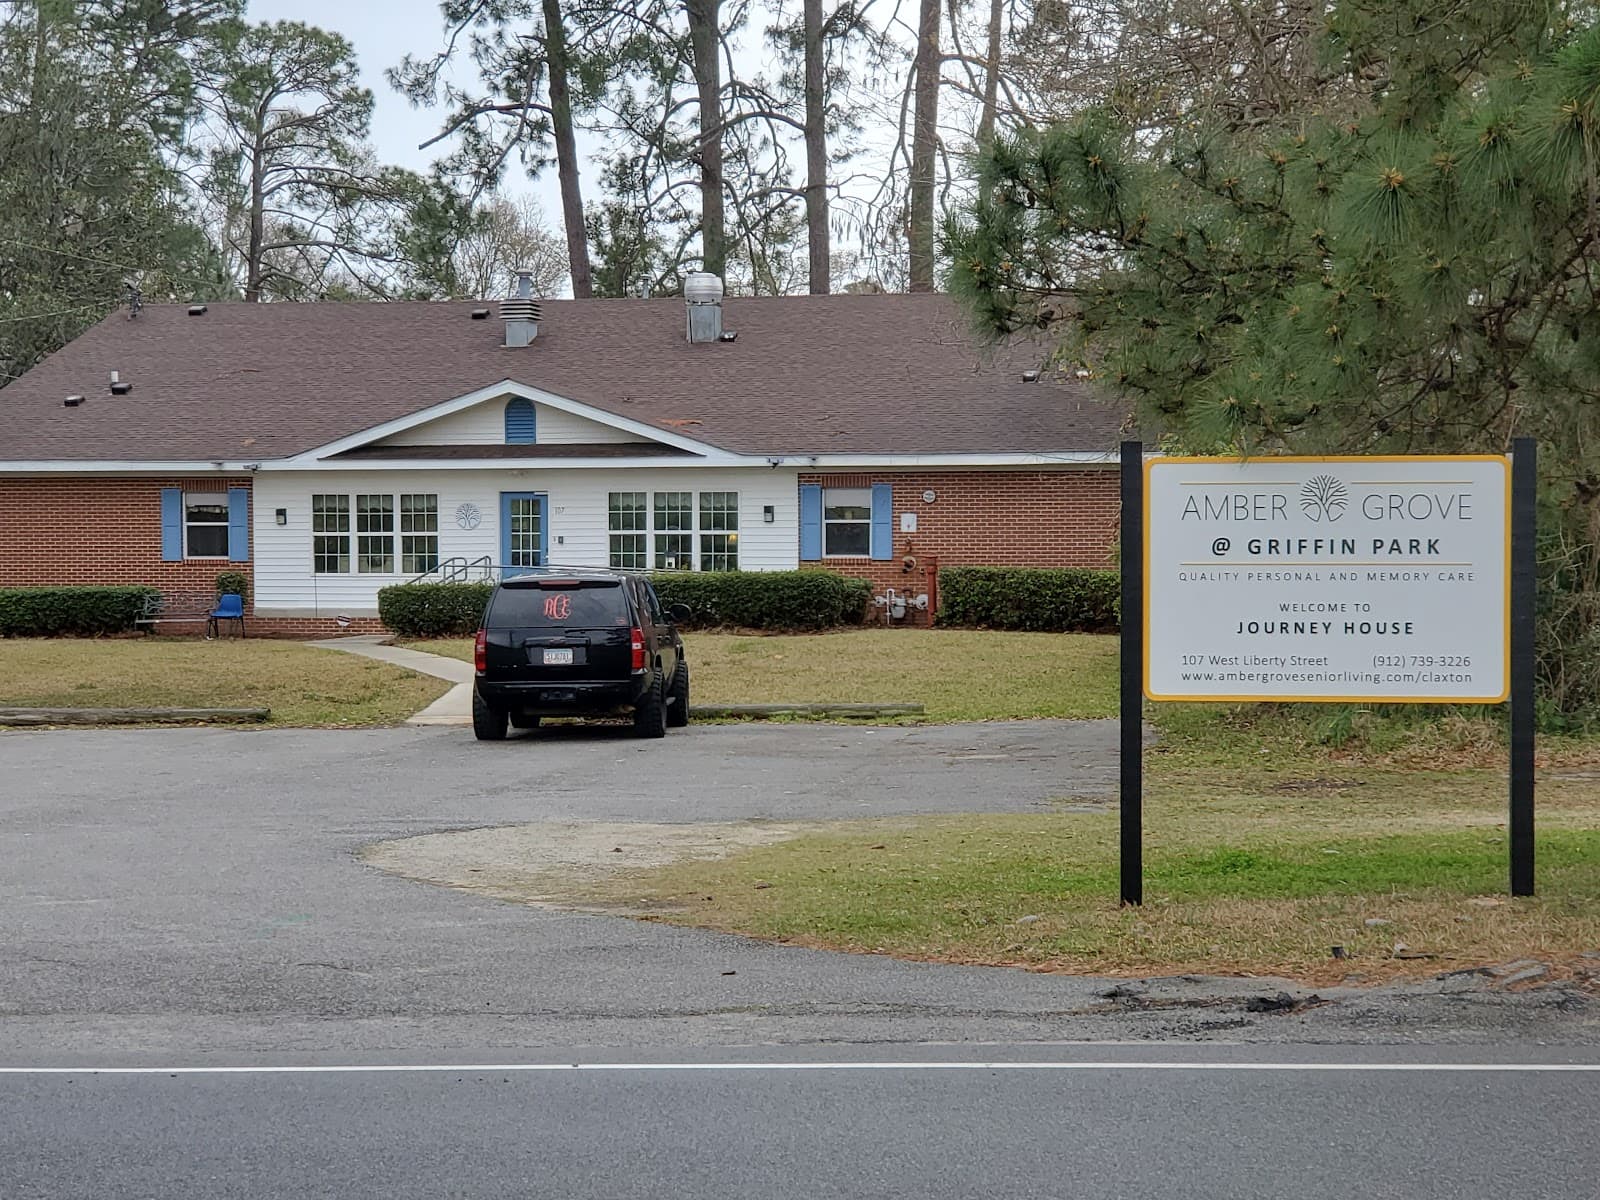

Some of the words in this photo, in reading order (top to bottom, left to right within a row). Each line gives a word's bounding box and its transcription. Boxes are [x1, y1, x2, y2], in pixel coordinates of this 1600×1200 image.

[1181, 494, 1288, 521] AMBER
[1362, 493, 1473, 521] GROVE
[1211, 537, 1232, 557] @
[1247, 538, 1356, 555] GRIFFIN
[1372, 538, 1441, 555] PARK
[1178, 571, 1240, 582] QUALITY
[1247, 572, 1321, 582] PERSONAL
[1329, 572, 1358, 582] AND
[1366, 572, 1430, 582] MEMORY
[1437, 572, 1475, 582] CARE
[1279, 602, 1347, 613] WELCOME
[1354, 603, 1371, 613] TO
[1236, 621, 1332, 635] JOURNEY
[1343, 621, 1414, 635] HOUSE
[1182, 654, 1204, 666] 107
[1208, 654, 1240, 666] West
[1243, 654, 1287, 669] Liberty
[1290, 654, 1329, 667] Street
[1373, 655, 1406, 668] (912)
[1410, 655, 1471, 667] 739-3226
[1181, 670, 1472, 685] www.ambergroveseniorliving.com/claxton
